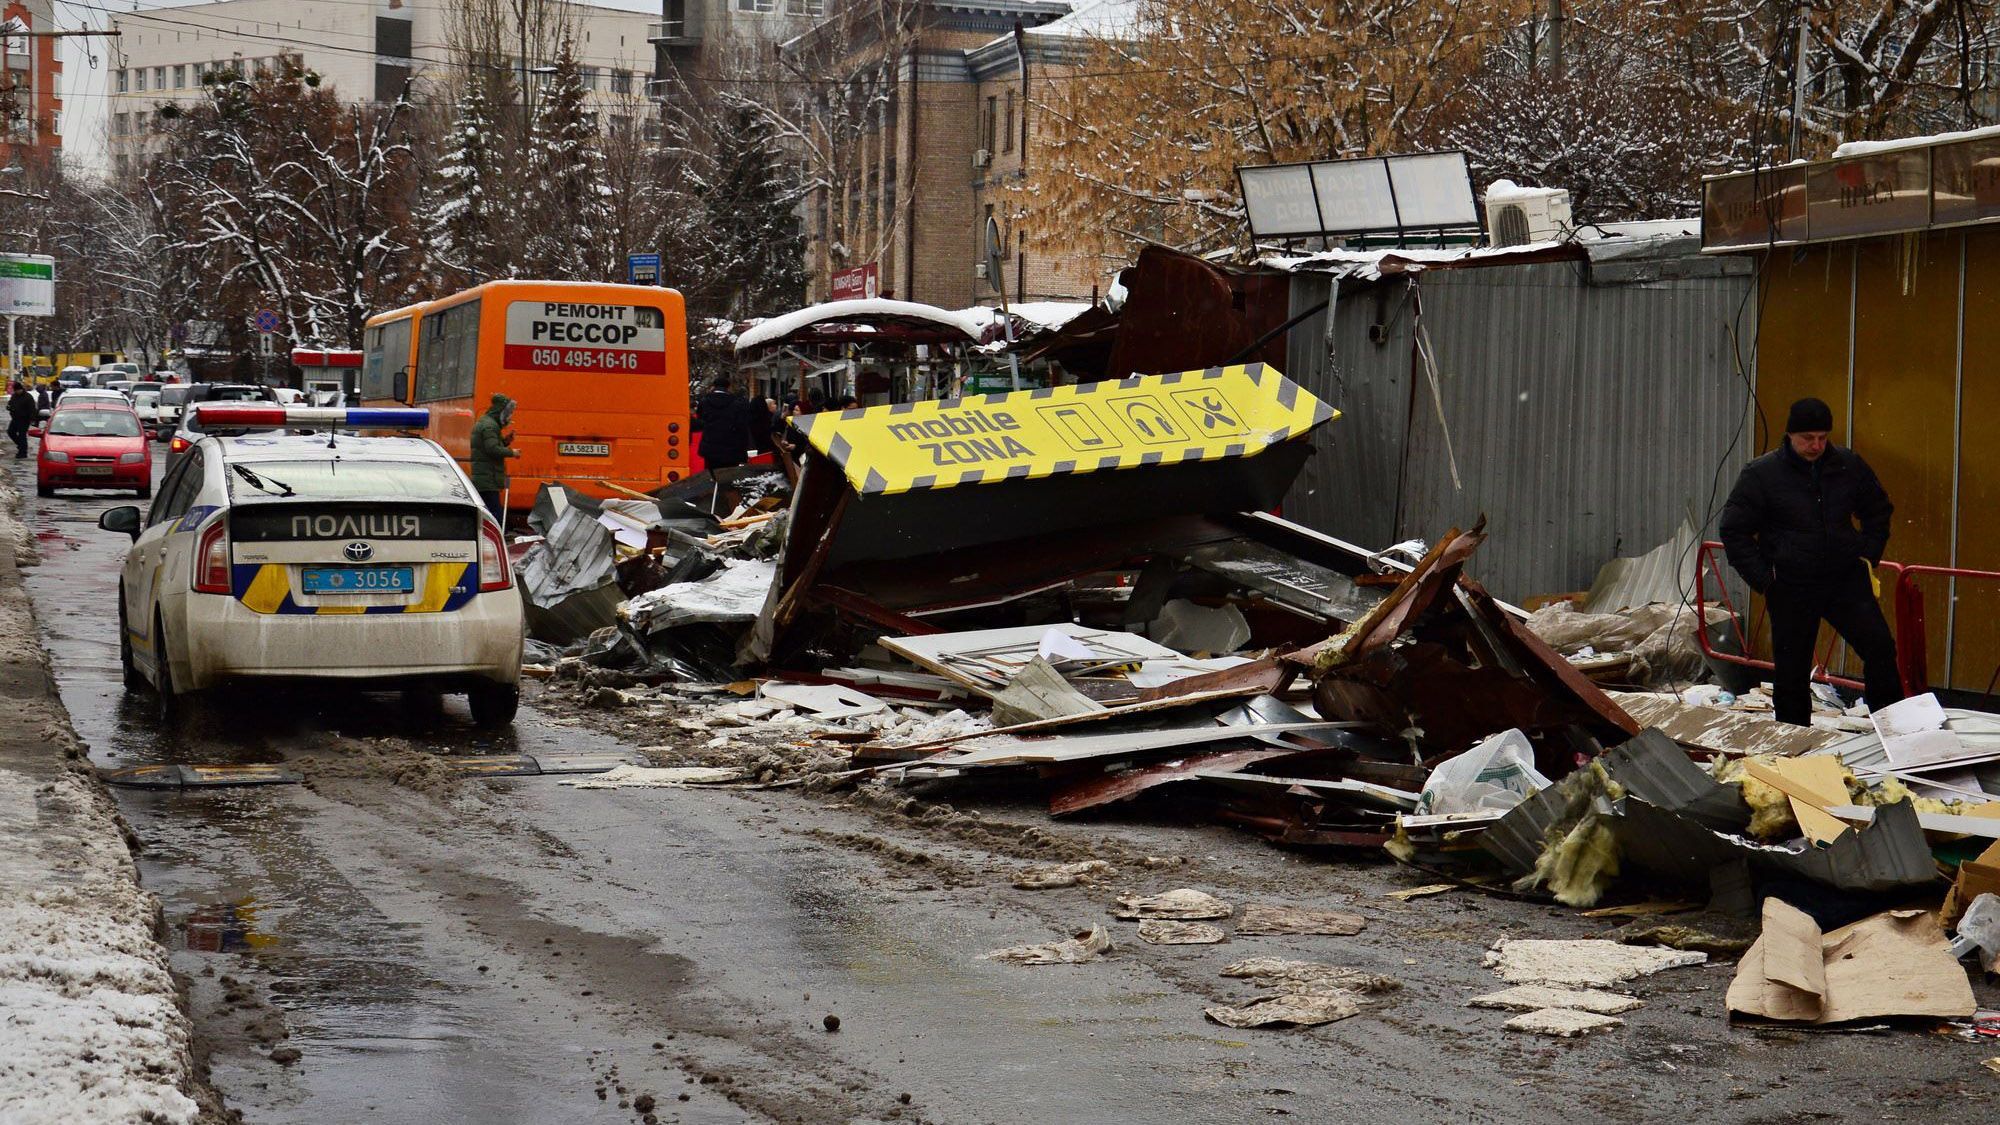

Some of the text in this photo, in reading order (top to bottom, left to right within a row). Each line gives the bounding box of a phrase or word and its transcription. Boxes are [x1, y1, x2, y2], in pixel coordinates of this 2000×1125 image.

[545, 303, 626, 319] РЕМОНТ
[532, 320, 638, 344] РЕССОР
[532, 349, 638, 369] 050 495-16-16
[887, 409, 1021, 441] mobile
[577, 445, 594, 453] 5823
[918, 435, 1037, 467] ZONA
[292, 515, 420, 537] ПОЛІЦІЯ
[355, 571, 401, 587] 3056
